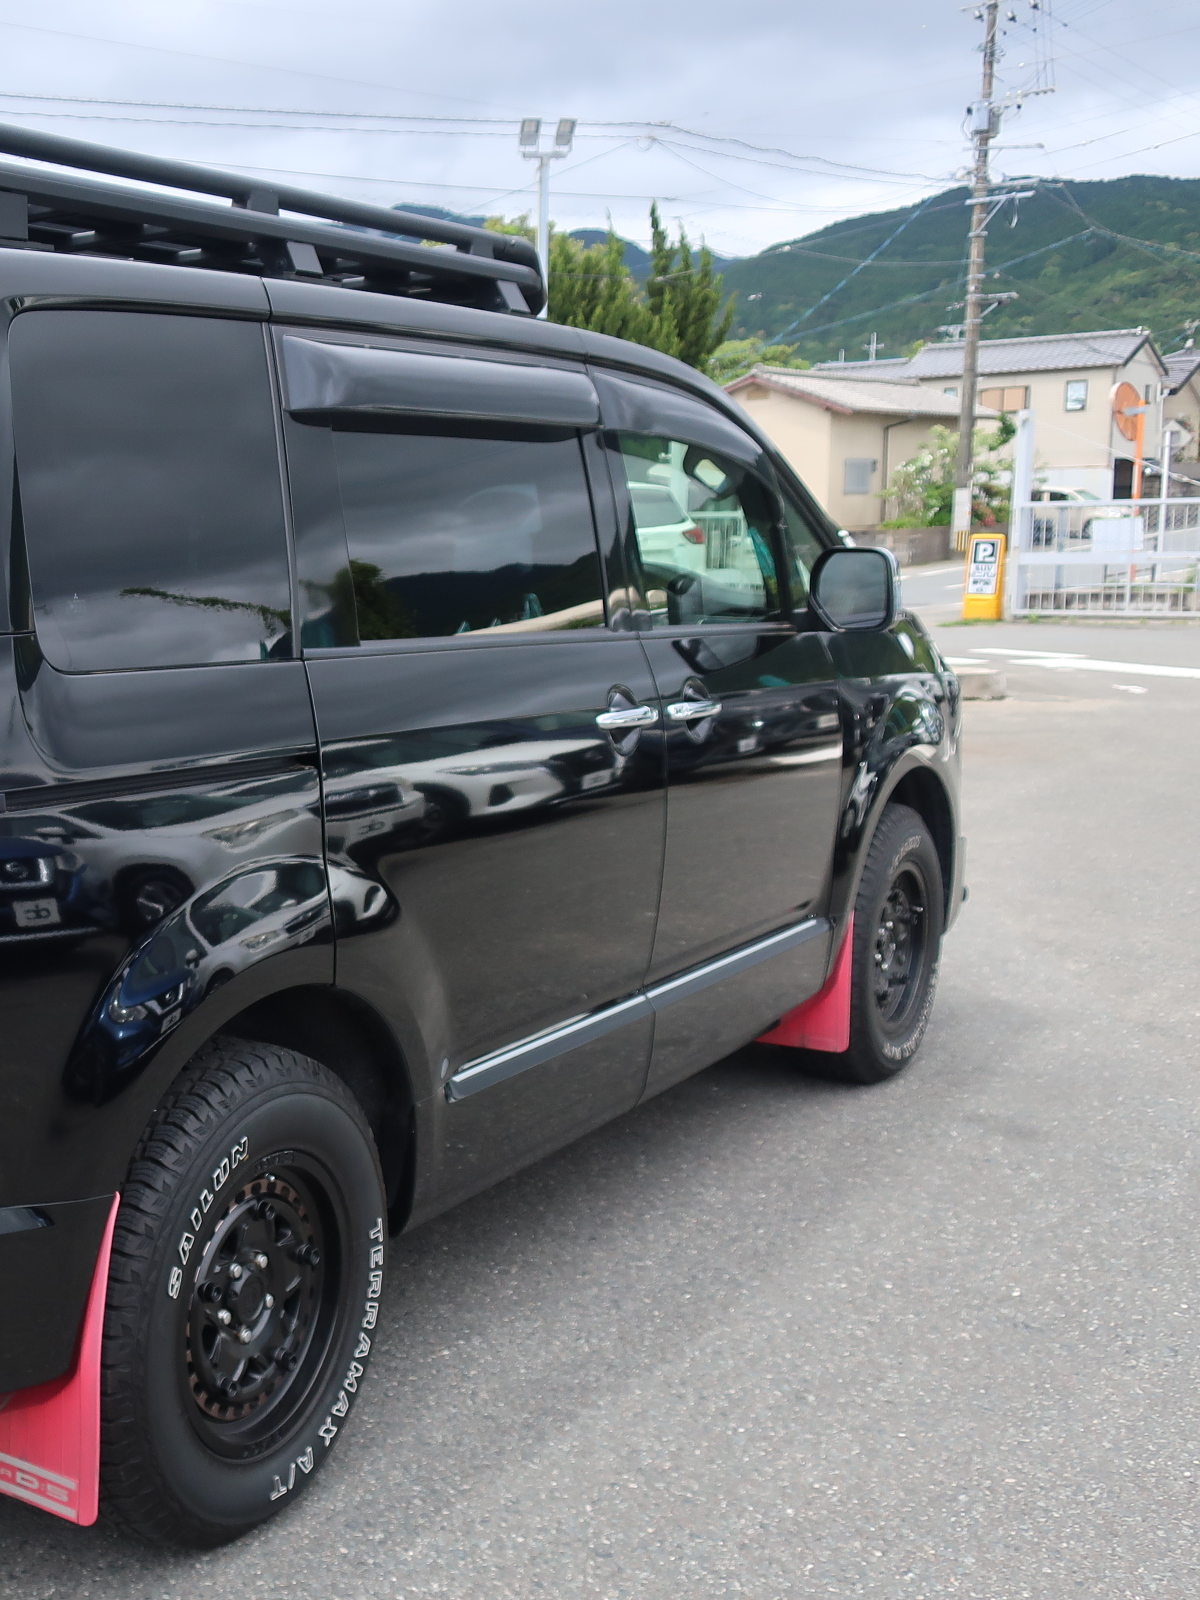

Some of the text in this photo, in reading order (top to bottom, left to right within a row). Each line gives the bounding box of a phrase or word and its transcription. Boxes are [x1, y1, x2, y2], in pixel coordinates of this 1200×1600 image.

[168, 1136, 249, 1299] SAILUN
[269, 1217, 384, 1501] TERRAMAX A/T
